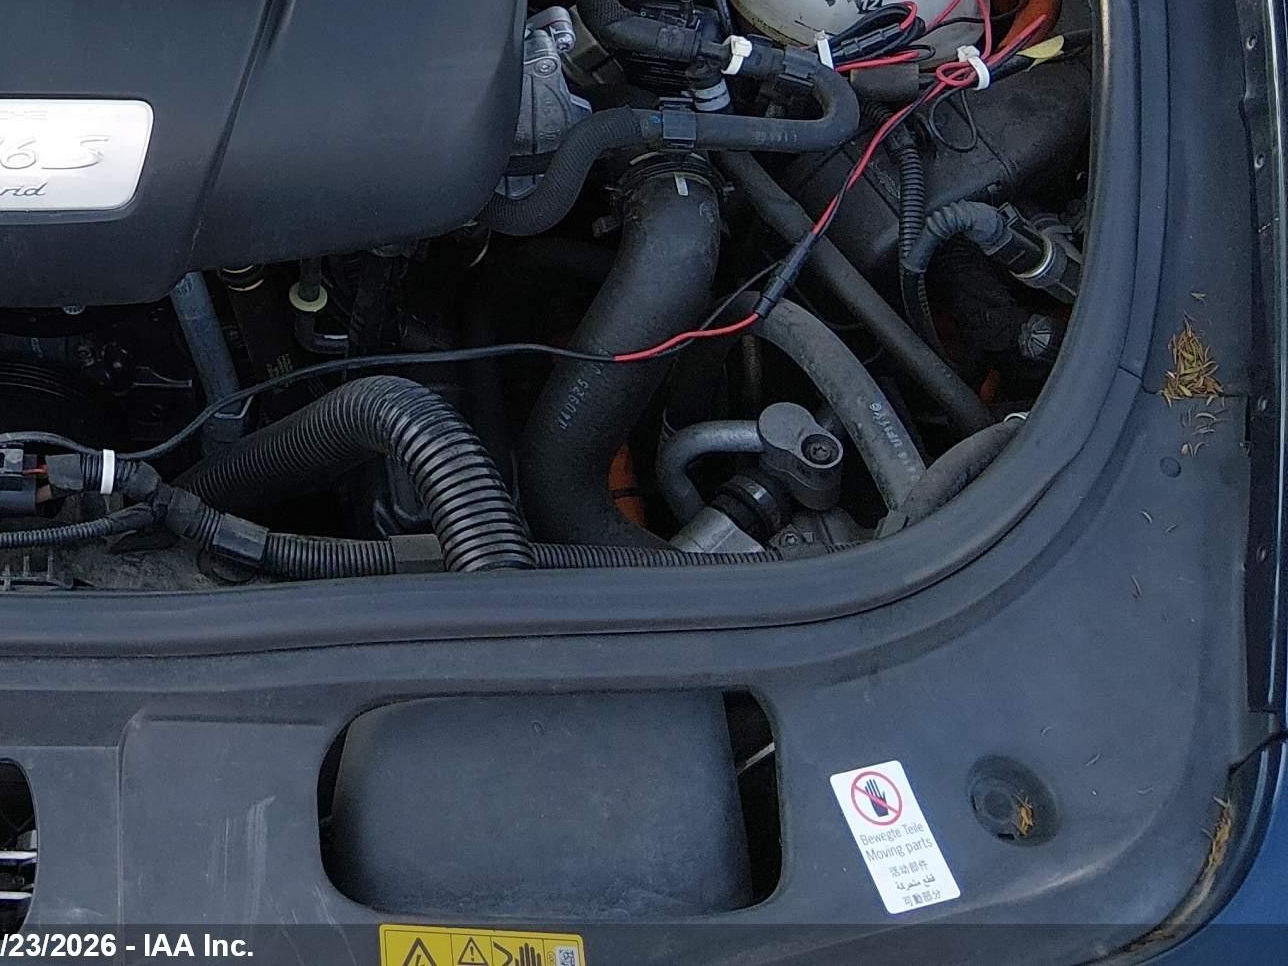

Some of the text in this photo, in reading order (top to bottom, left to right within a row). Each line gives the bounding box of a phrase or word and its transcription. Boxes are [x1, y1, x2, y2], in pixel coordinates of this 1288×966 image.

[41, 135, 110, 170] S
[859, 822, 925, 846] Bewegte Teile
[865, 837, 934, 862] Moving parts
